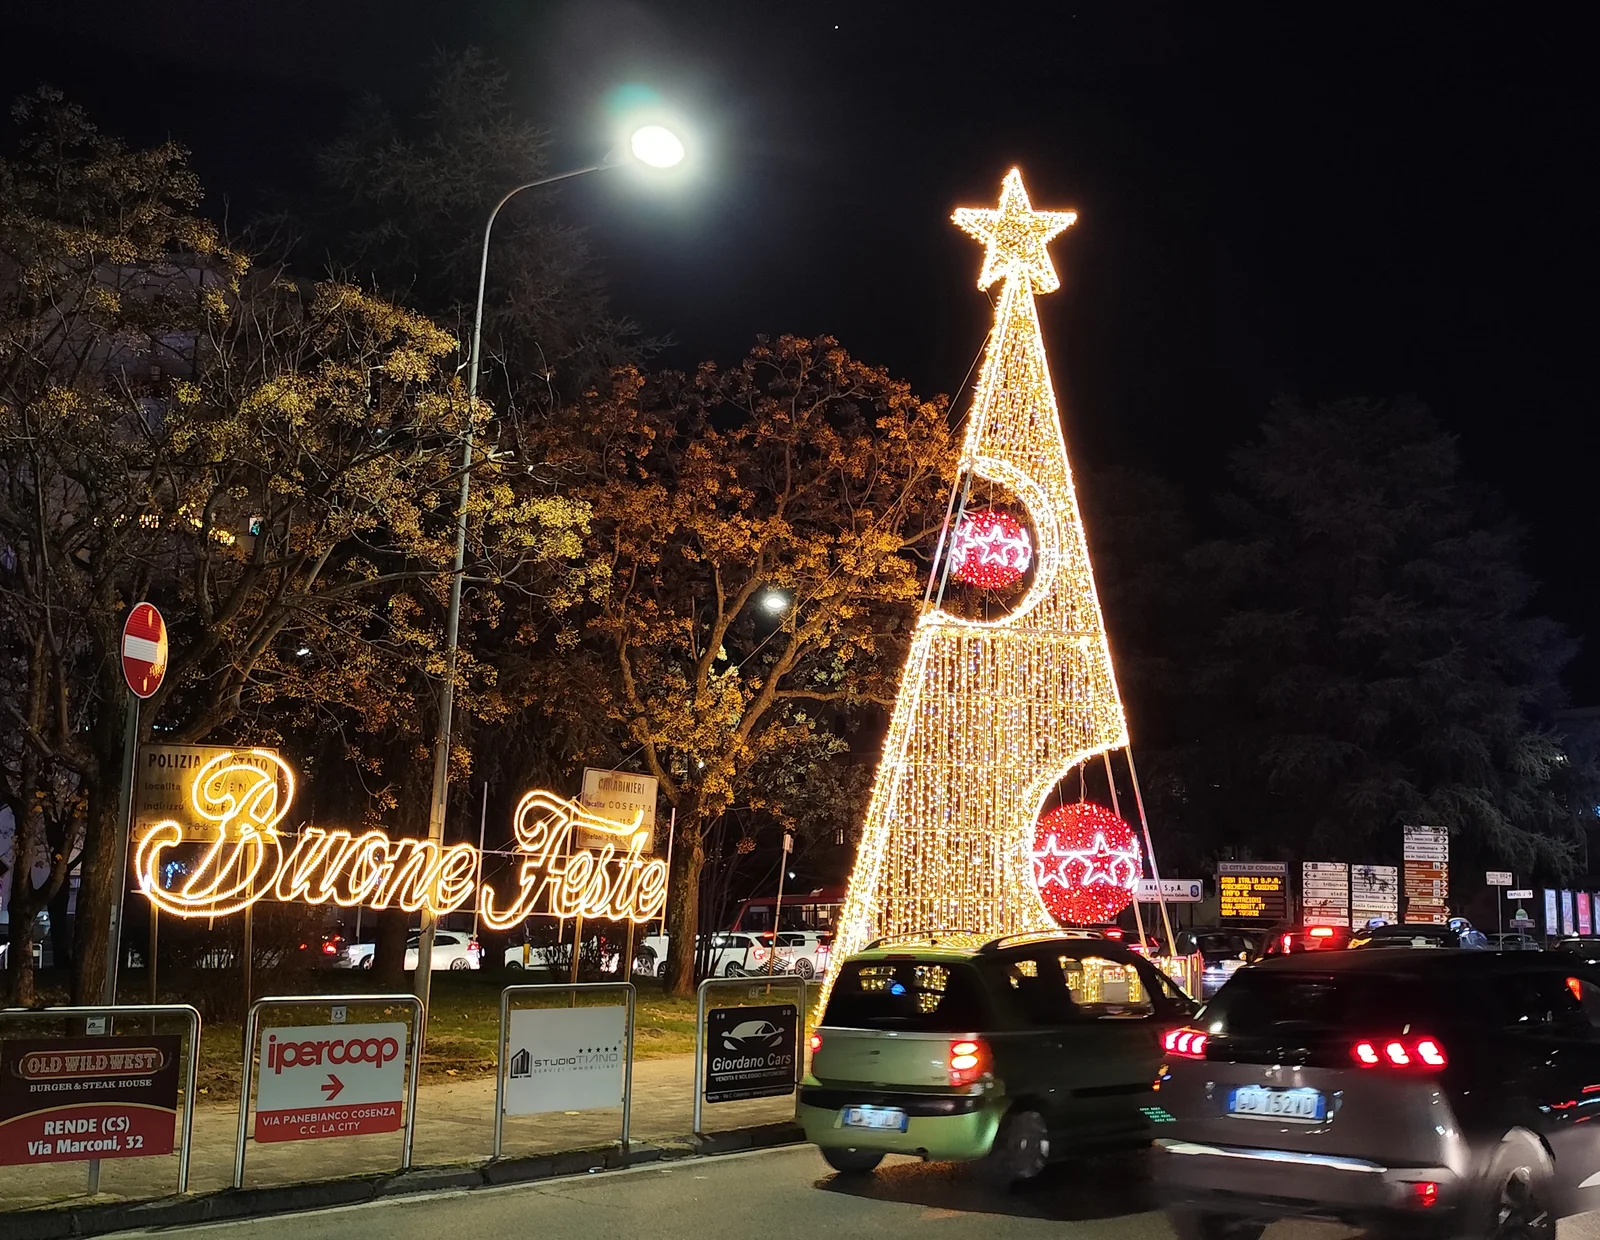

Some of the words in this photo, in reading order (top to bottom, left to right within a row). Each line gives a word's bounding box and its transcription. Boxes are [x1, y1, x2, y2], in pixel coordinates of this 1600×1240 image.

[148, 753, 201, 769] POLIZIA
[598, 778, 645, 795] CARABINIERI
[608, 800, 652, 813] COSENZA
[135, 750, 480, 917] Buone
[481, 789, 668, 930] Feste
[1165, 883, 1183, 892] S.p.A.
[27, 1057, 62, 1074] OLD
[65, 1055, 108, 1072] WILD
[109, 1053, 157, 1070] WEST
[267, 1034, 399, 1075] ipercoop
[712, 1055, 764, 1071] Giordano
[767, 1053, 792, 1066] Cars
[29, 1083, 73, 1092] BURGER
[82, 1080, 116, 1090] STEAK
[118, 1079, 152, 1088] HOUSE
[44, 1118, 97, 1135] RENDE
[102, 1116, 130, 1135] (CS)
[262, 1116, 280, 1126] VIA
[283, 1110, 349, 1124] PANEBIANCO
[351, 1107, 396, 1118] COSENZA
[300, 1125, 319, 1135] C.C.
[322, 1124, 336, 1133] LA
[338, 1121, 360, 1132] CITY
[27, 1140, 52, 1156] Via
[56, 1135, 121, 1154] Marconi,
[126, 1135, 144, 1149] 32
